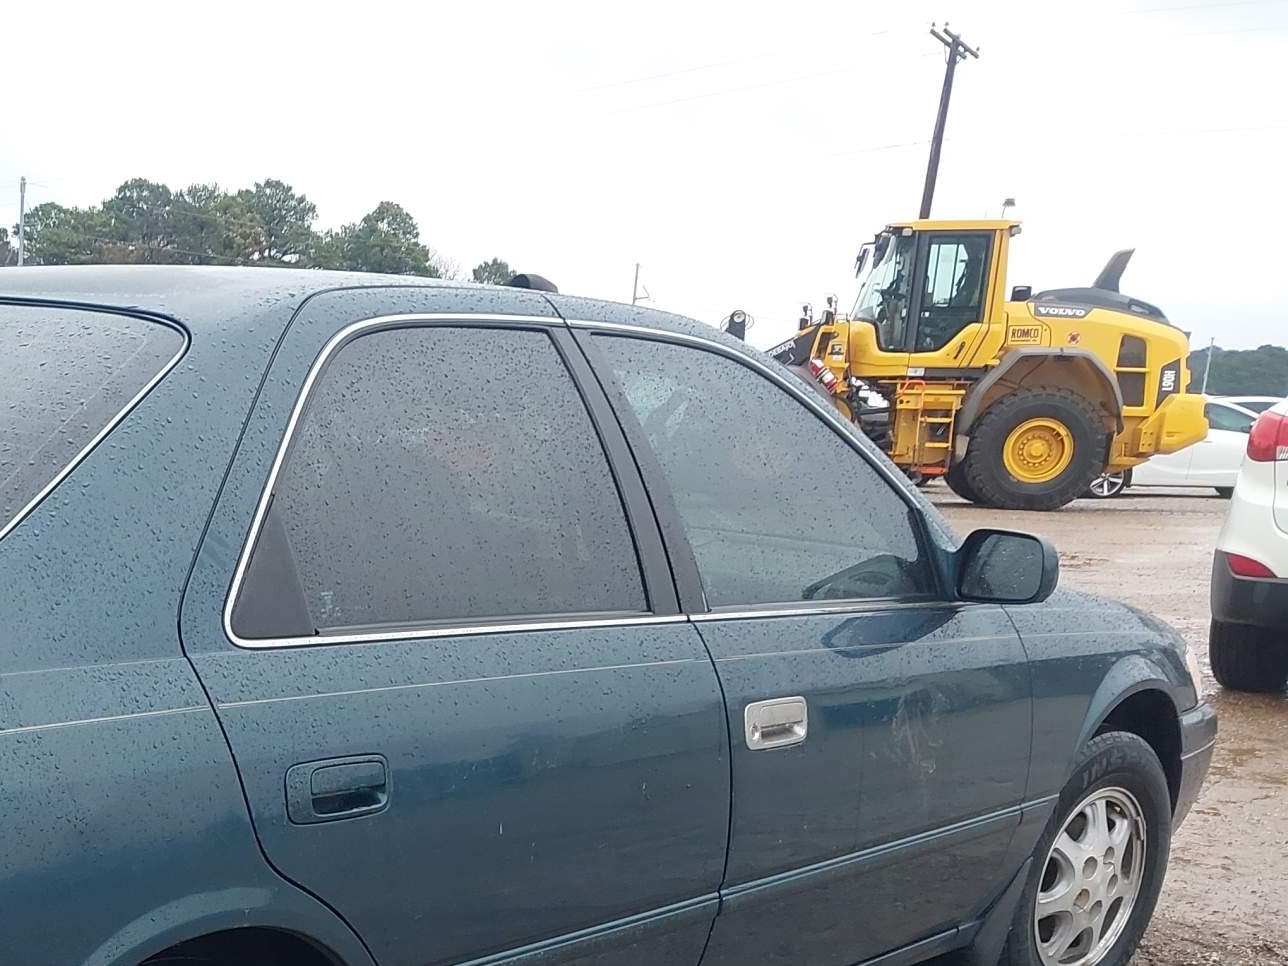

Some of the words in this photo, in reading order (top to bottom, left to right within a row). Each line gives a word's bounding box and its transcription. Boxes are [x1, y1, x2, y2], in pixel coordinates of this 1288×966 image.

[1038, 307, 1086, 316] VOLVO
[1011, 328, 1039, 338] ROMCO
[1161, 370, 1176, 391] L90H
